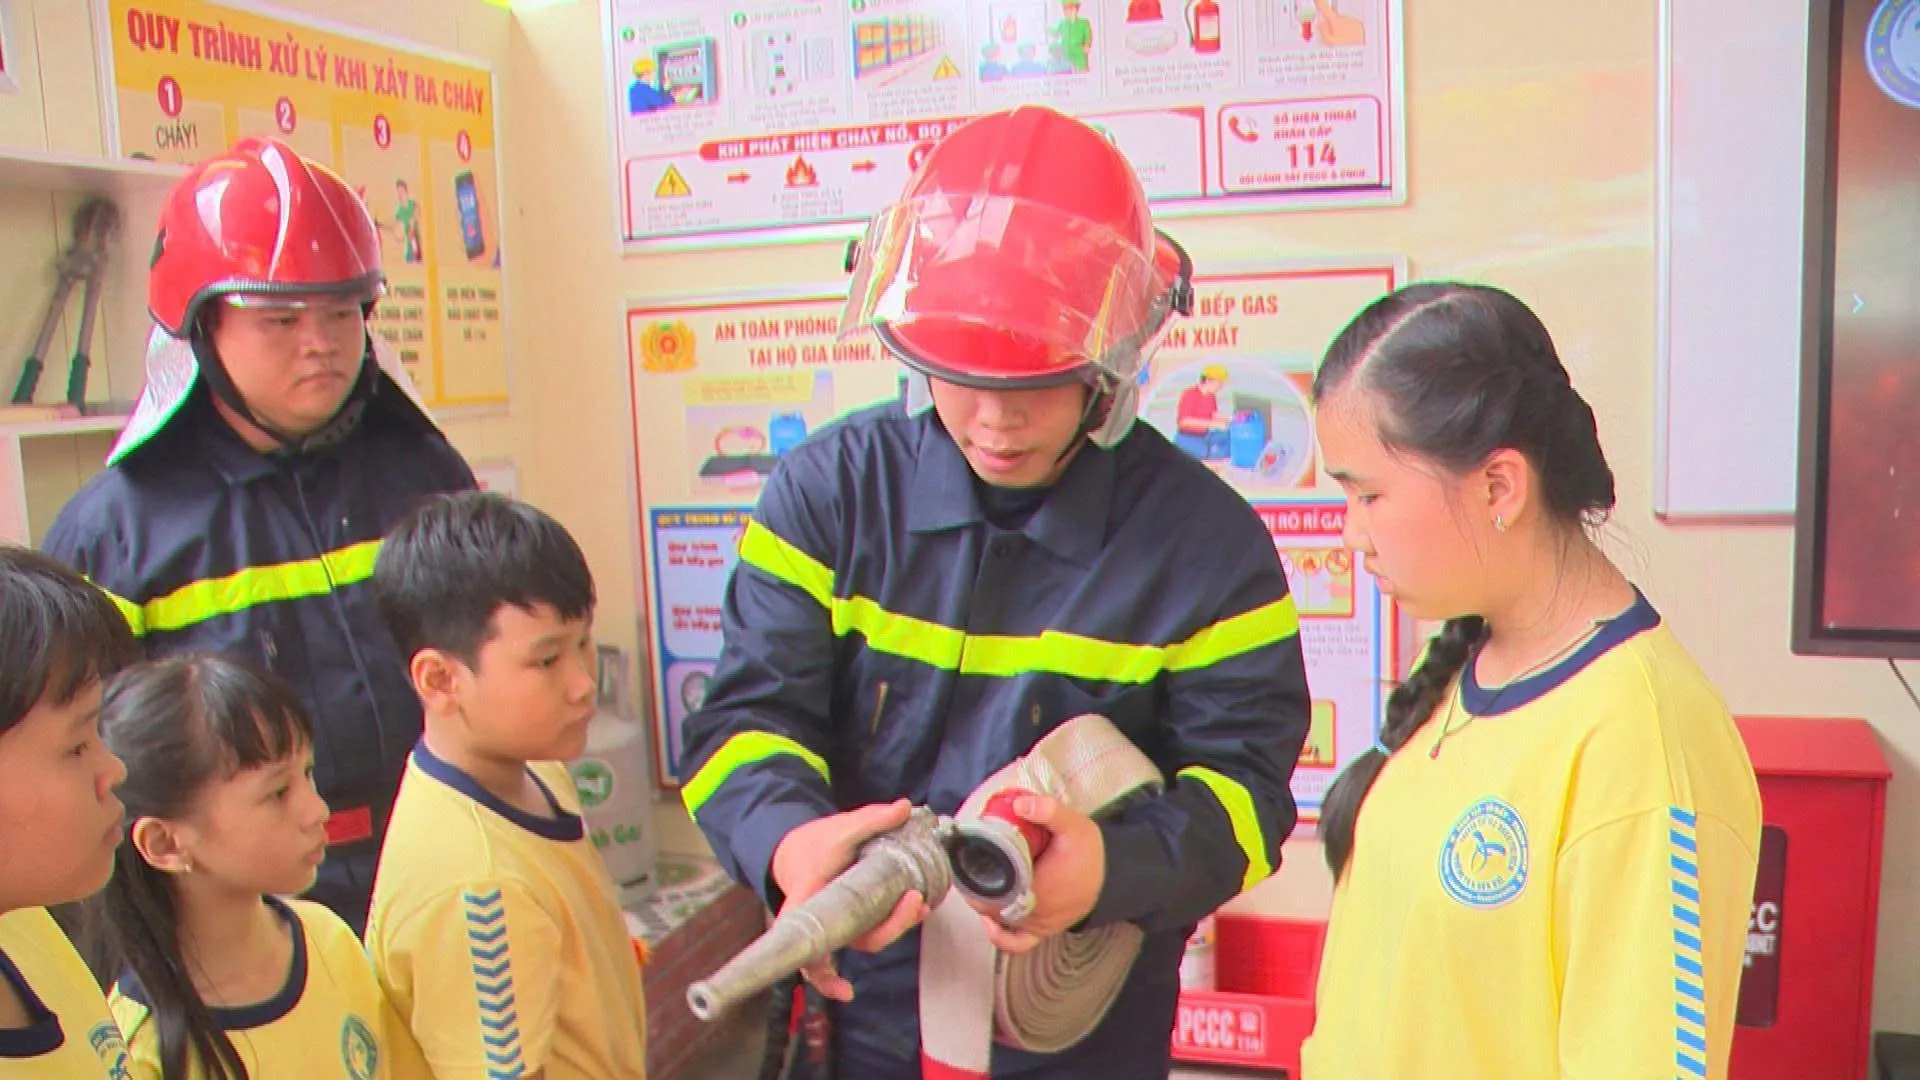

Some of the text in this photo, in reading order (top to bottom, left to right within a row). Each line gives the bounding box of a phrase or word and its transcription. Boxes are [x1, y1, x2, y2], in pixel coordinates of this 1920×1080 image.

[127, 8, 180, 55] QUY
[187, 20, 262, 70] TRÌNH
[268, 31, 300, 77] XỬ
[304, 44, 327, 82] LÝ
[334, 55, 368, 92] KHI
[414, 73, 438, 106] RA
[442, 80, 483, 116] CHÁY
[164, 80, 175, 113] 1
[279, 102, 292, 131] 2
[376, 117, 387, 146] 3
[718, 142, 745, 160] KHI
[750, 137, 789, 157] PHÁT
[793, 132, 832, 153] HIỆN
[836, 125, 880, 148] CHÁY
[1286, 141, 1337, 169] 114
[1200, 288, 1278, 316] BẾP GAS
[716, 321, 735, 342] AN
[741, 318, 780, 340] TOÀN
[784, 315, 837, 338] PHÒNG
[1193, 319, 1239, 348] XUẤT
[749, 347, 771, 370] TẠI
[776, 345, 797, 368] HỘ
[802, 344, 827, 364] GIA
[1178, 1006, 1235, 1047] PCCC
